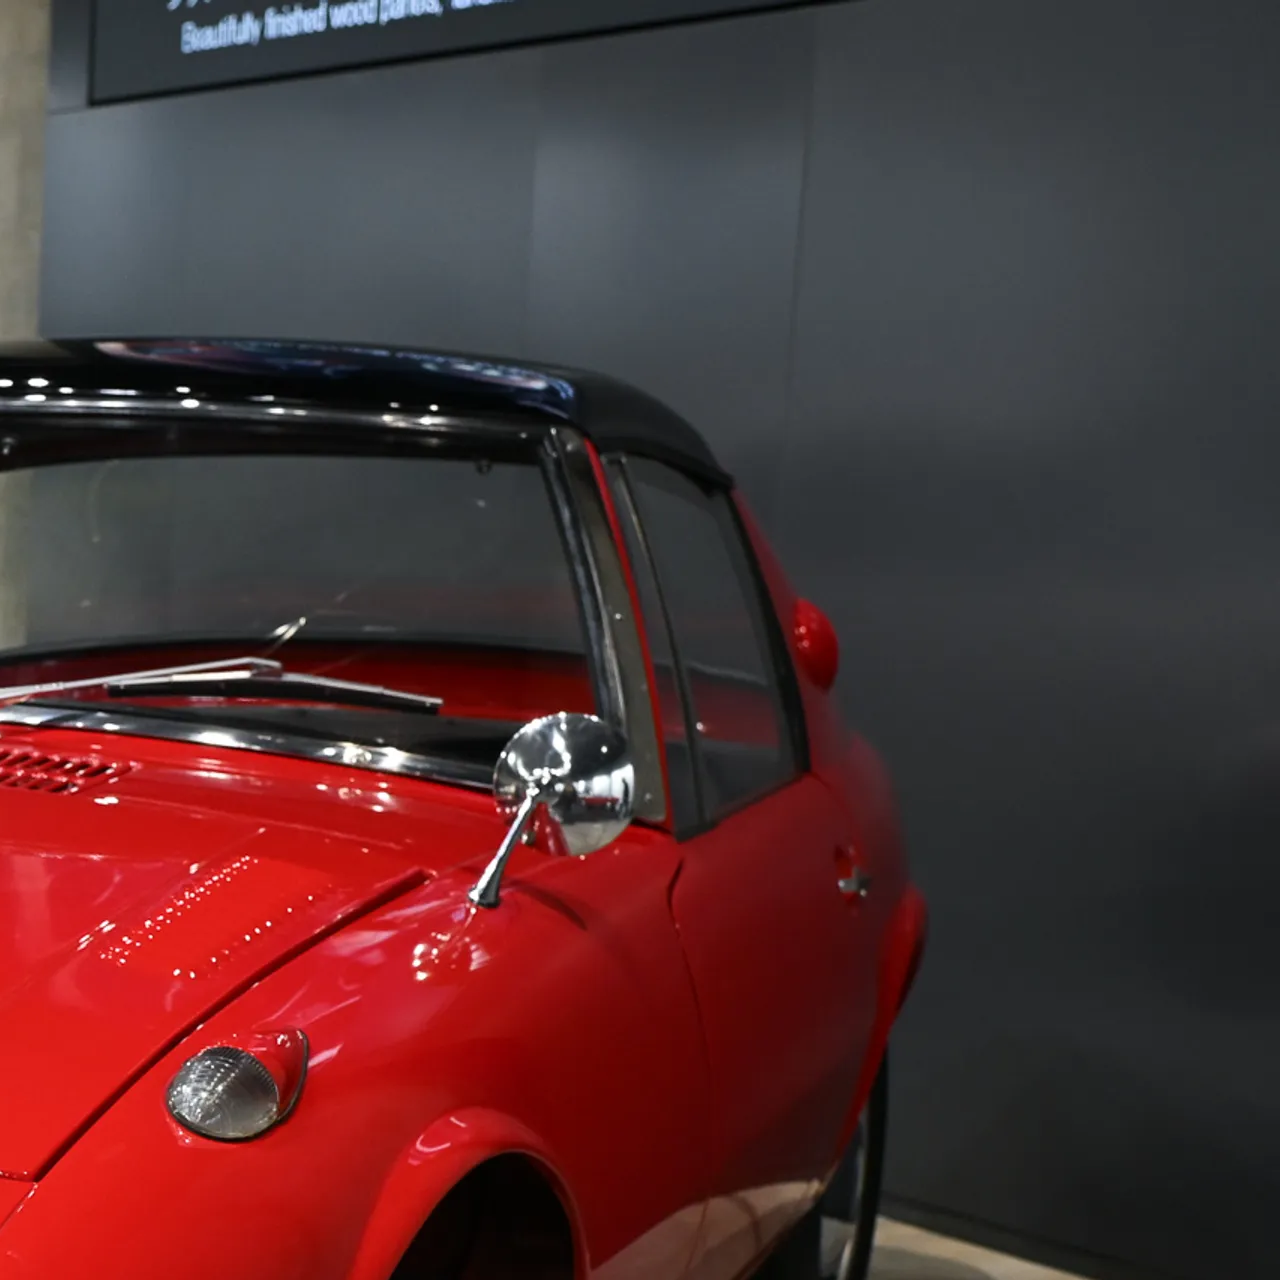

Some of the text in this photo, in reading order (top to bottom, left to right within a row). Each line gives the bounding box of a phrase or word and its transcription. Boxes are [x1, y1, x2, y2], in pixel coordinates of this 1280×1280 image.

[181, 11, 263, 53] Beautifully
[264, 4, 327, 40] finished
[330, 0, 378, 29] wood
